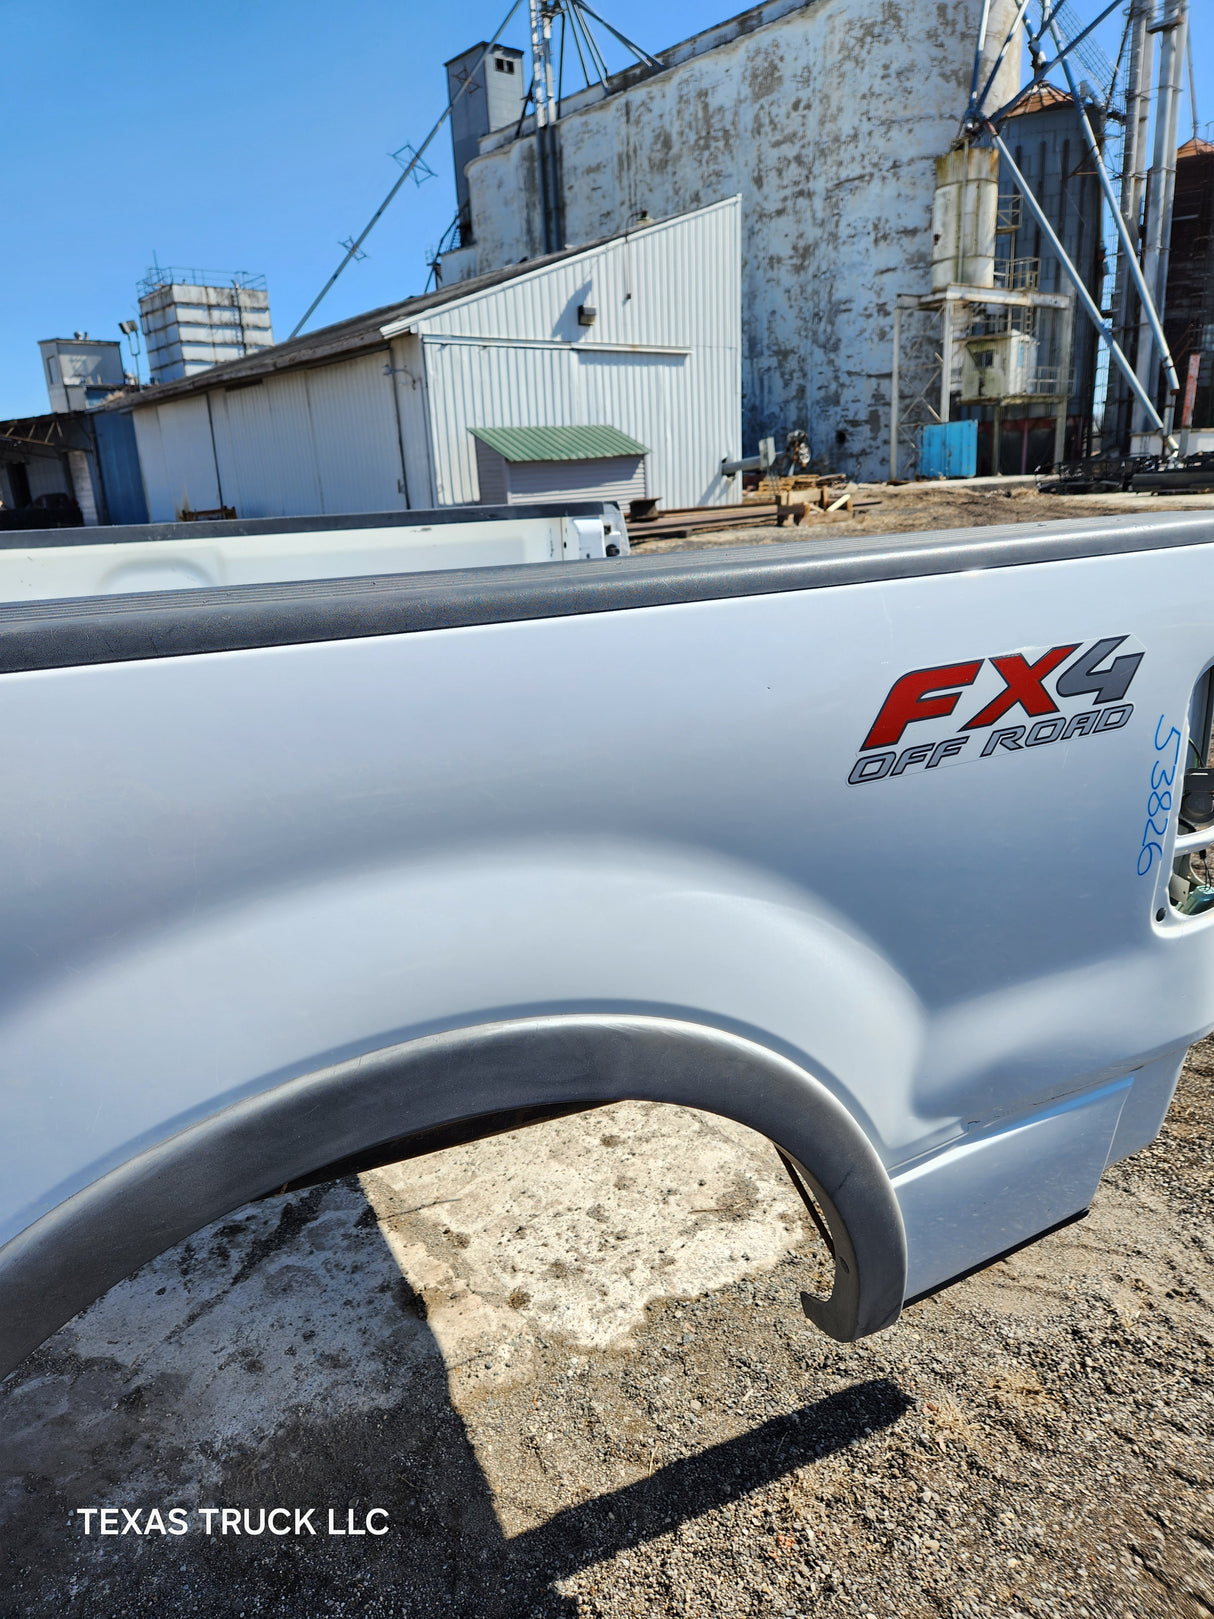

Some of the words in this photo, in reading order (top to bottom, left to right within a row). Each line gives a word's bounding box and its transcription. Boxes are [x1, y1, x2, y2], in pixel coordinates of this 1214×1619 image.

[847, 735, 970, 785] OFF
[980, 703, 1134, 758] ROAD
[859, 634, 1145, 752] FX4
[1137, 714, 1181, 876] 53826
